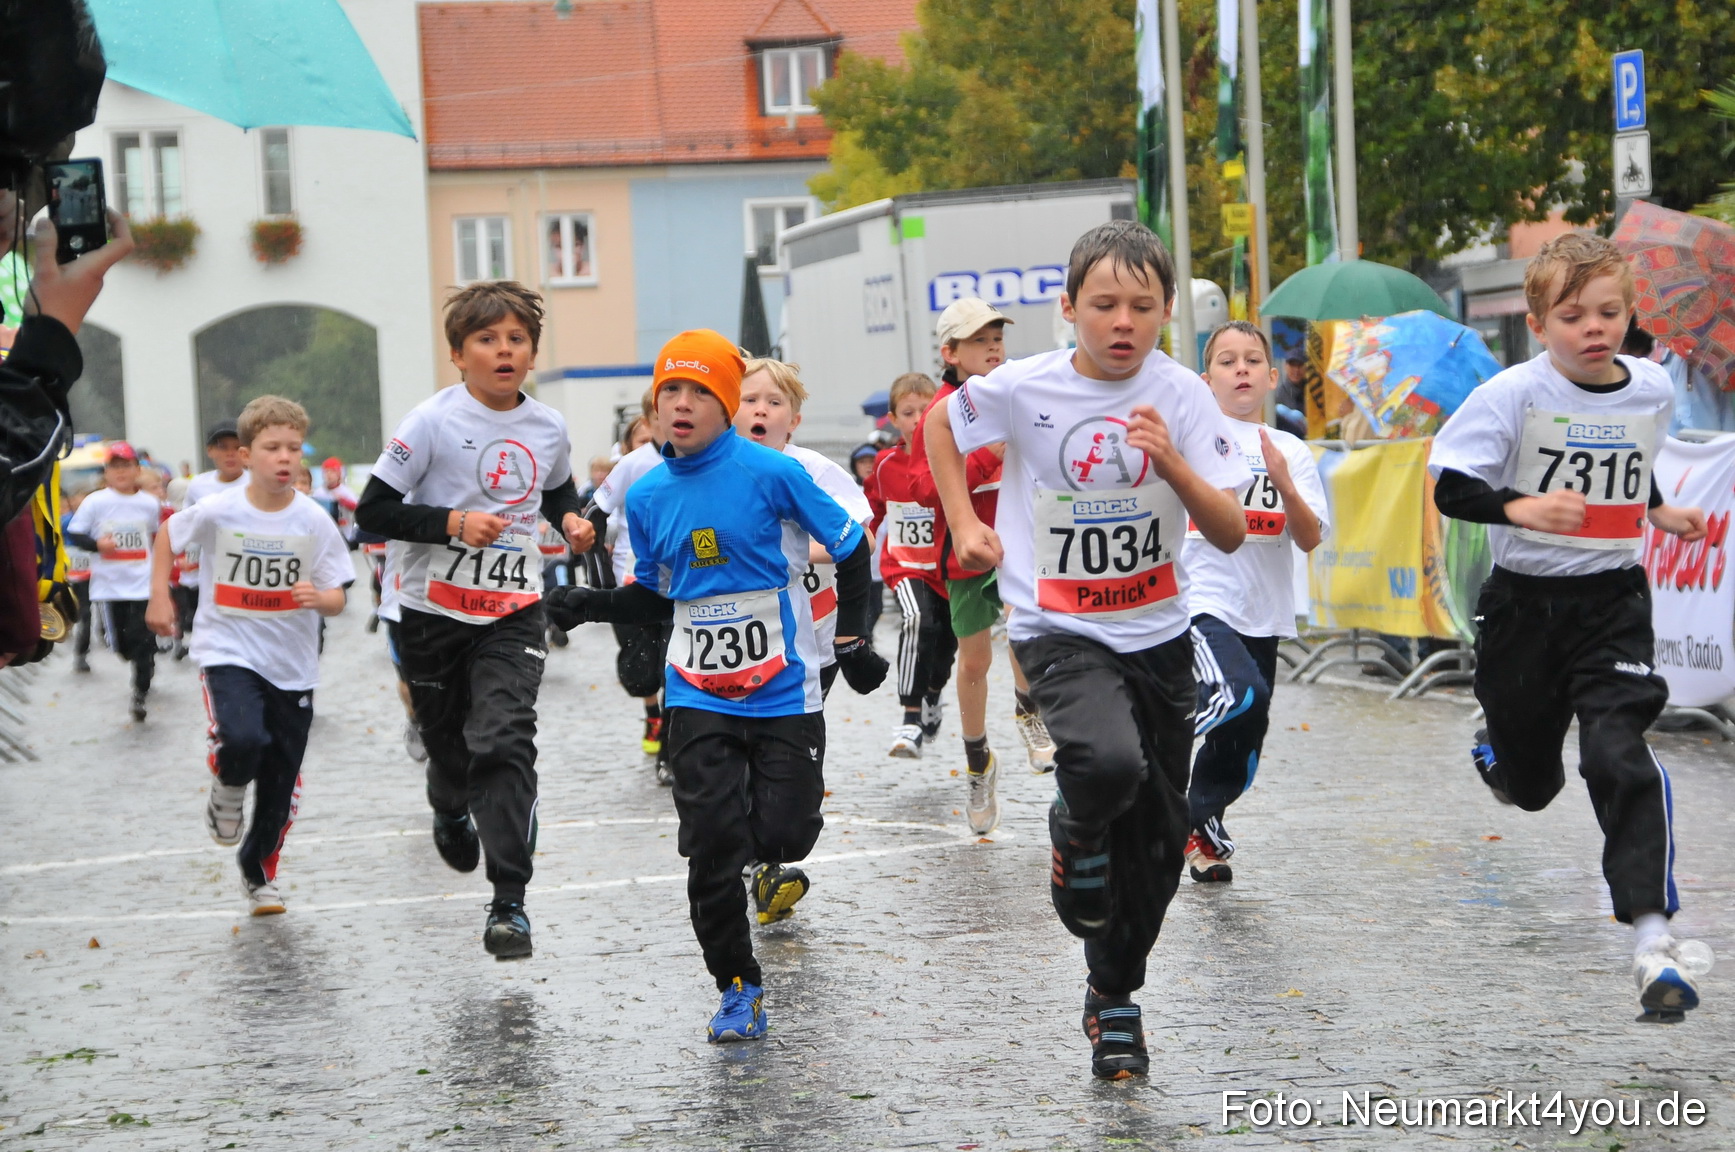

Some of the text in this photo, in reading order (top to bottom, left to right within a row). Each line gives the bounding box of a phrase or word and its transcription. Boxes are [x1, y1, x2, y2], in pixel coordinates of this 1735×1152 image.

[1621, 62, 1638, 120] P
[928, 264, 1069, 312] BOC
[676, 360, 710, 374] odlo
[1034, 421, 1055, 429] erima
[1566, 424, 1627, 440] BOCK
[1538, 447, 1643, 500] 7316
[1244, 474, 1278, 509] 75
[1073, 497, 1138, 515] BOCK
[115, 532, 142, 548] 306
[896, 520, 934, 545] 733
[1050, 517, 1162, 575] 7034
[226, 552, 301, 587] 7058
[446, 544, 528, 590] 7144
[241, 592, 282, 608] Kilian
[461, 593, 506, 613] Lukas
[1077, 581, 1147, 607] Patrick
[689, 602, 738, 618] BOCK
[683, 620, 769, 670] 7230
[1686, 634, 1724, 672] Radio
